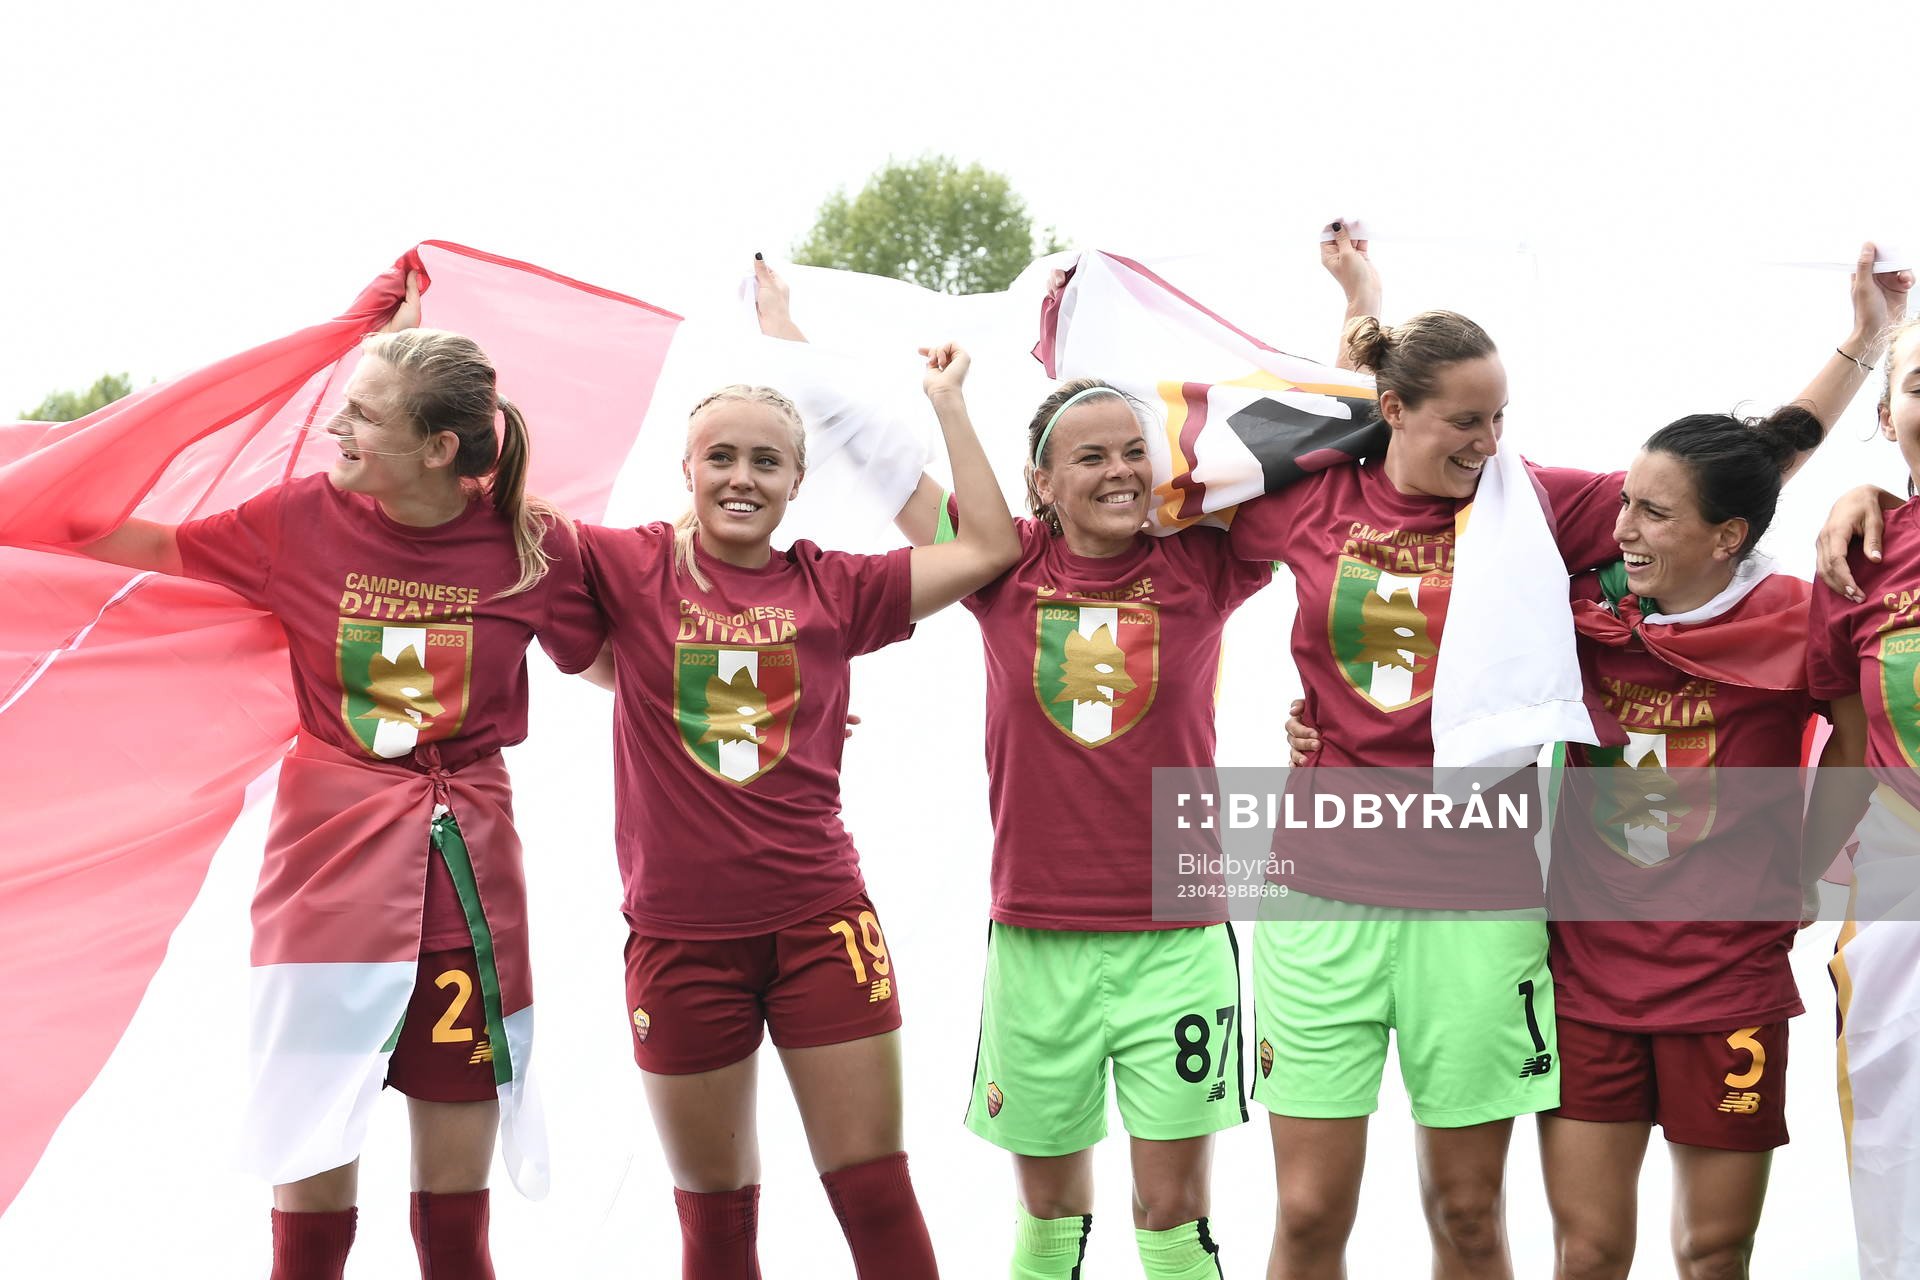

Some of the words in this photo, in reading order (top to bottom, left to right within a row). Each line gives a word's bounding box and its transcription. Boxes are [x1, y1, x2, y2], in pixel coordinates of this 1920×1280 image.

[1349, 522, 1455, 548] CAMPIONESS
[345, 572, 480, 605] CAMPIONESSE
[1343, 565, 1379, 581] 2022
[1422, 576, 1452, 588] 202
[680, 599, 797, 627] CAMPIONESSE
[1045, 609, 1078, 622] 2022
[1119, 612, 1154, 625] 2023
[345, 627, 381, 643] 2022
[427, 633, 465, 648] 2023
[676, 615, 799, 644] D'ITALIA
[682, 652, 717, 666] 2022
[761, 654, 793, 667] 2023
[1668, 736, 1707, 750] 2023
[828, 910, 891, 984] 19
[1518, 979, 1546, 1053] 1
[1174, 1005, 1235, 1084] 87
[1723, 1026, 1767, 1089] 3
